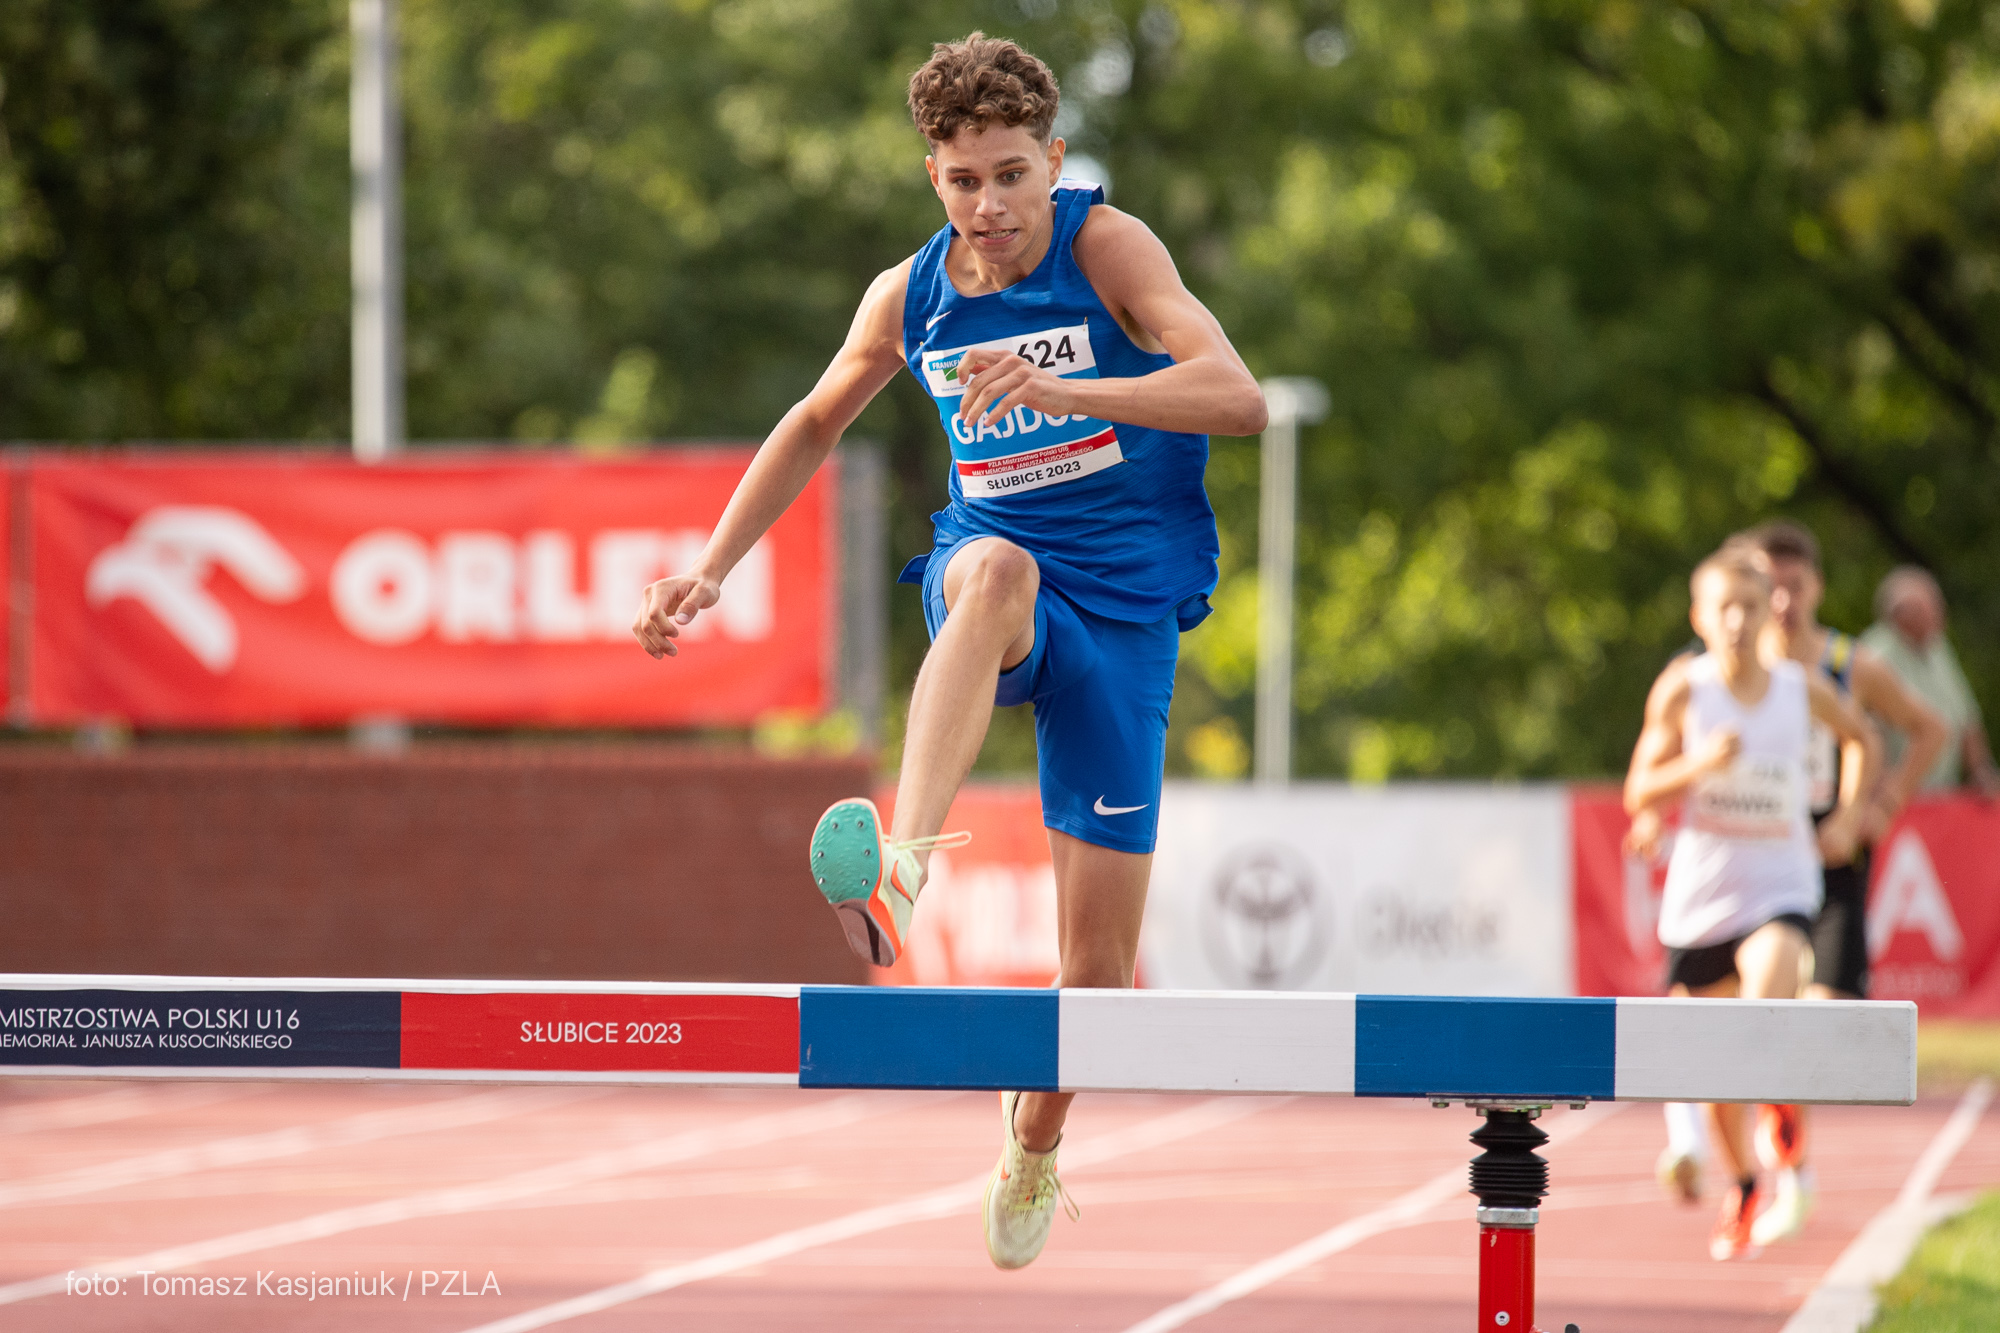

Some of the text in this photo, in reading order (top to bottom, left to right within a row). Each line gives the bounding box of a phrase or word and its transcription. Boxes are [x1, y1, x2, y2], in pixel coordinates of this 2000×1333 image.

[988, 460, 1003, 468] PZLA
[1002, 453, 1039, 465] Mistrzostwa
[1039, 448, 1058, 458] Polski
[1016, 458, 1044, 470] JANUSZA
[987, 460, 1081, 490] SŁUBICE 2023
[0, 1008, 300, 1030] MISTRZOSTWA POLSKI U16
[0, 1031, 292, 1050] EMORIAŁ JANUSZA KUSOCIŃSKIEGO
[520, 1021, 683, 1044] SŁUBICE 2023
